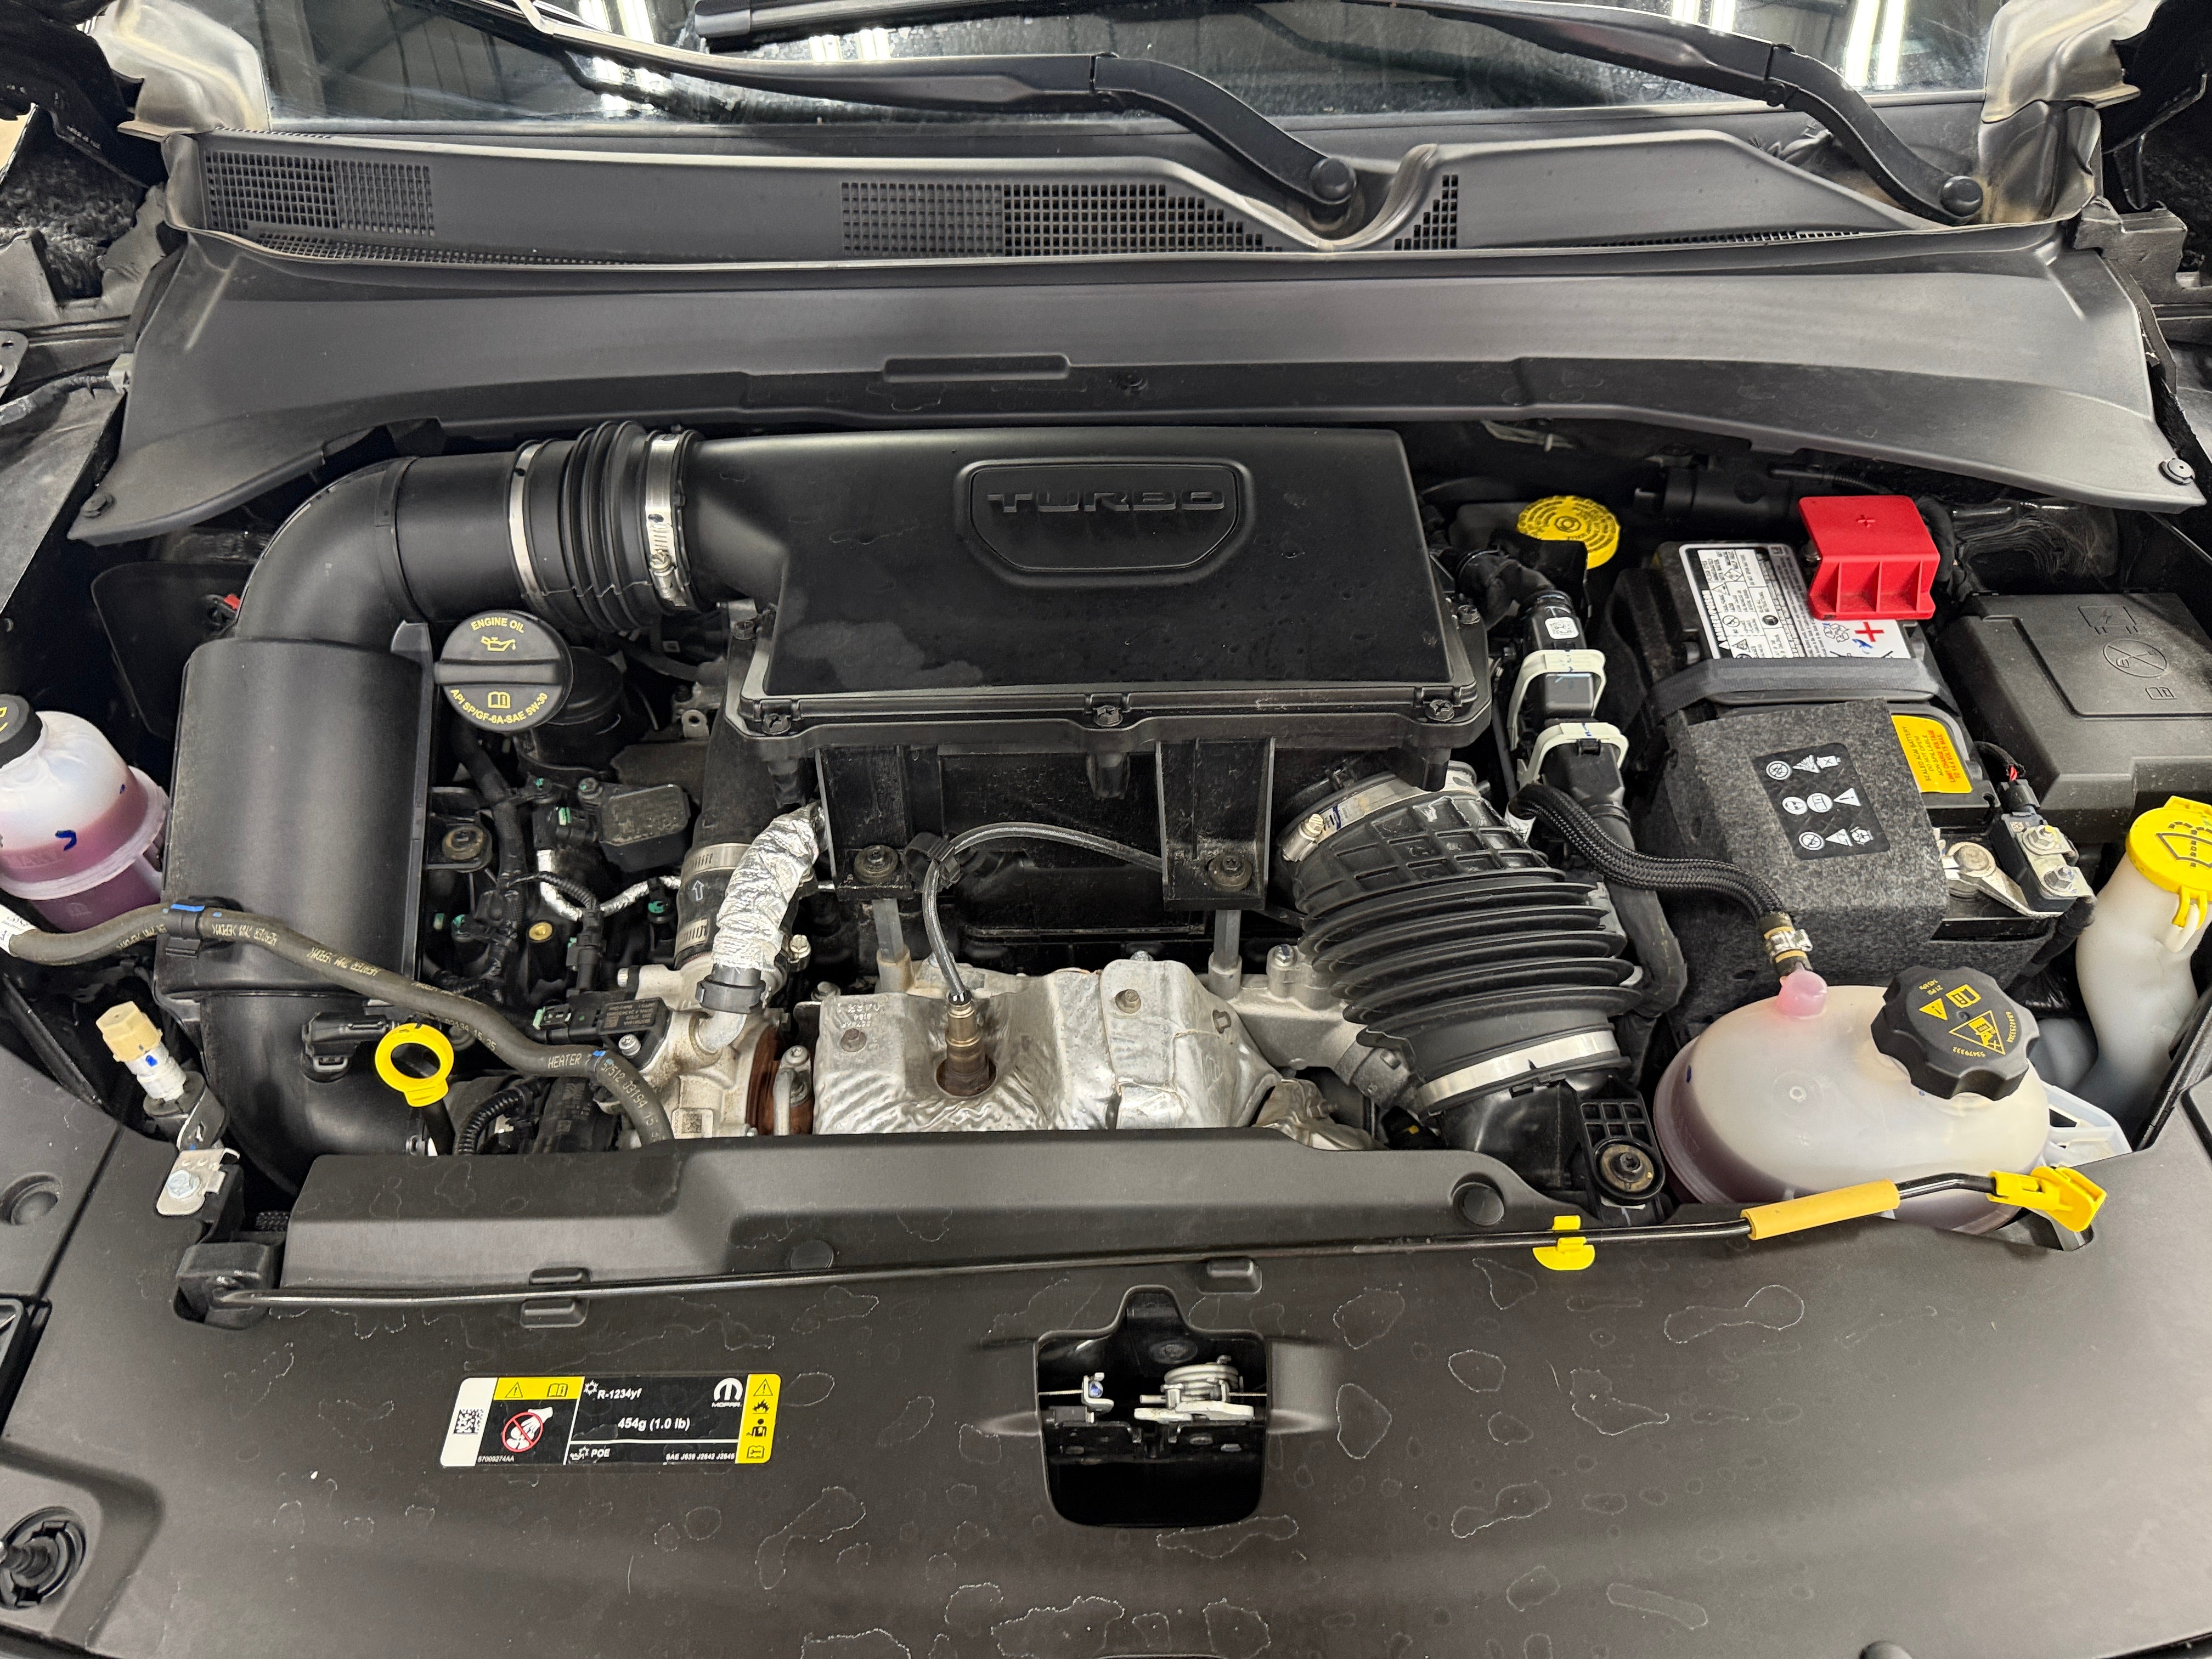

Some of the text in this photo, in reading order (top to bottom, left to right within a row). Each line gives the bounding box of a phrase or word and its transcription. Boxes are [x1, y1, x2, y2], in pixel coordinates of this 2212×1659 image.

[986, 490, 1226, 514] TURBO
[470, 617, 525, 634] ENGINE OIL
[1701, 590, 1727, 641] DANGER/POISON
[450, 689, 465, 705] API
[526, 692, 548, 716] 5W-30
[1901, 726, 1931, 781] SEALED AGM BATTERY
[1921, 734, 1944, 776] NON SPILLABLE
[1921, 752, 1930, 763] NOT
[548, 1053, 582, 1069] HEATER
[623, 1080, 648, 1109] 03194
[597, 1387, 642, 1400] R-1234yf
[618, 1417, 691, 1432] 454g (1.0 lb)
[590, 1447, 611, 1458] POE
